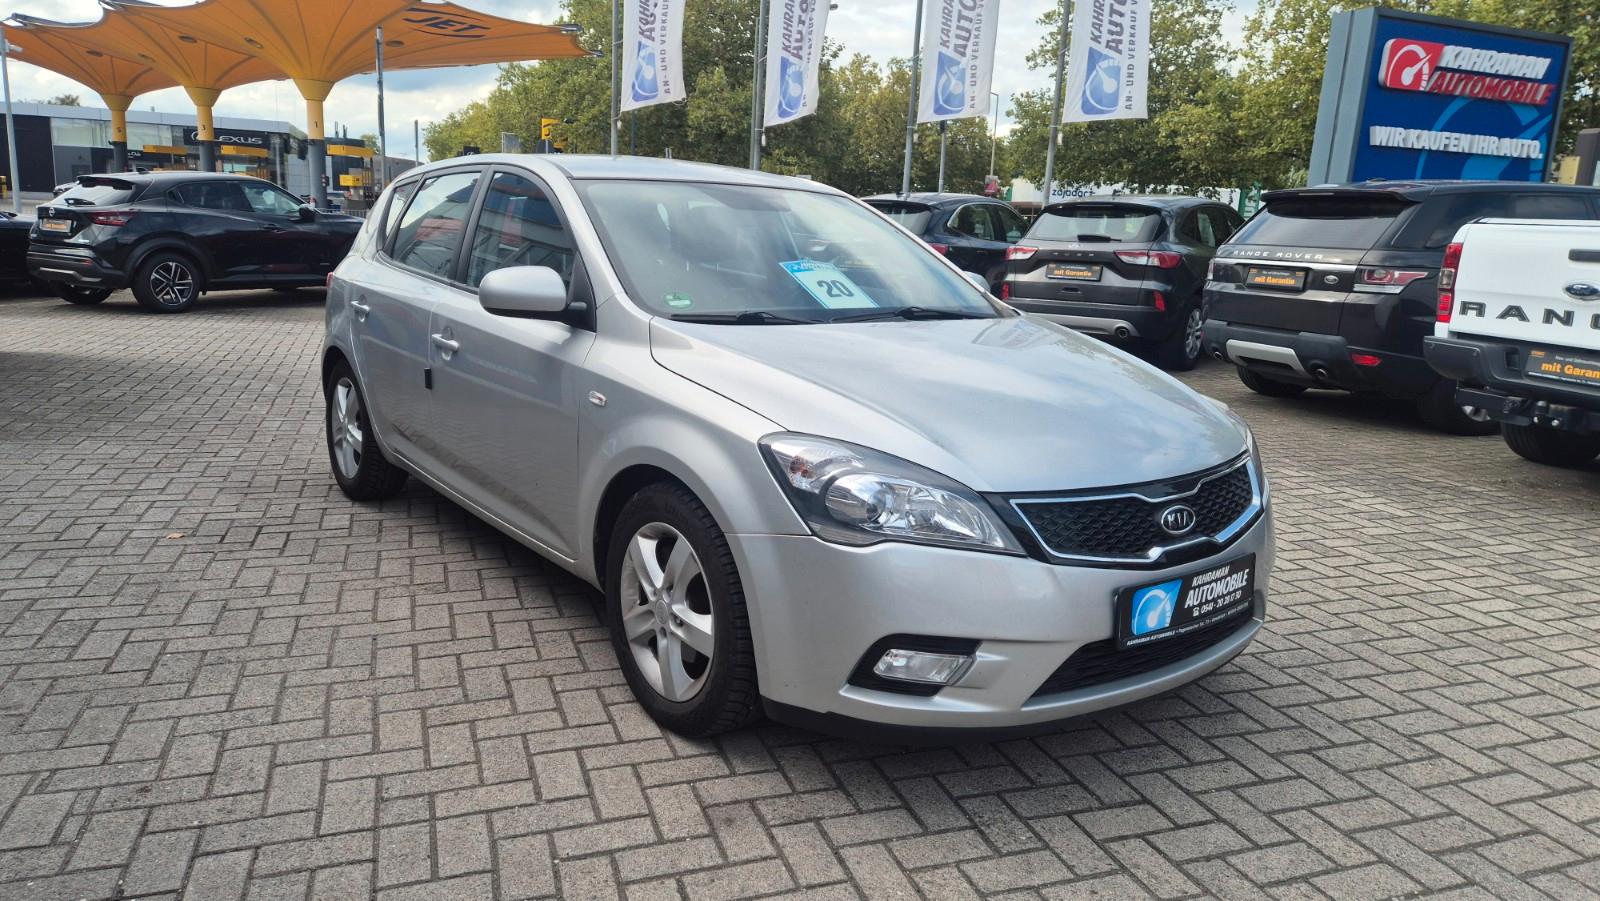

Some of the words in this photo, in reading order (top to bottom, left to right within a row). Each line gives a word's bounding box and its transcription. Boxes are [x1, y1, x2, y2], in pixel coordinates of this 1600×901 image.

[402, 16, 491, 32] JET
[782, 0, 795, 54] KAHRA
[1127, 10, 1138, 60] VERKAUF
[1126, 64, 1135, 86] UND
[1441, 45, 1551, 79] KAHRAMAN
[1427, 71, 1554, 105] AUTOMOBILE
[1370, 126, 1405, 147] WIR
[1405, 129, 1470, 153] KAUFEN
[1470, 134, 1499, 155] IHR
[1497, 138, 1543, 159] AUTO.
[1276, 252, 1324, 260] ROVER
[816, 279, 855, 298] 20
[1541, 361, 1562, 373] mit
[1184, 568, 1250, 608] AUTOMOBILE
[1192, 566, 1230, 587] KAHRAMAN
